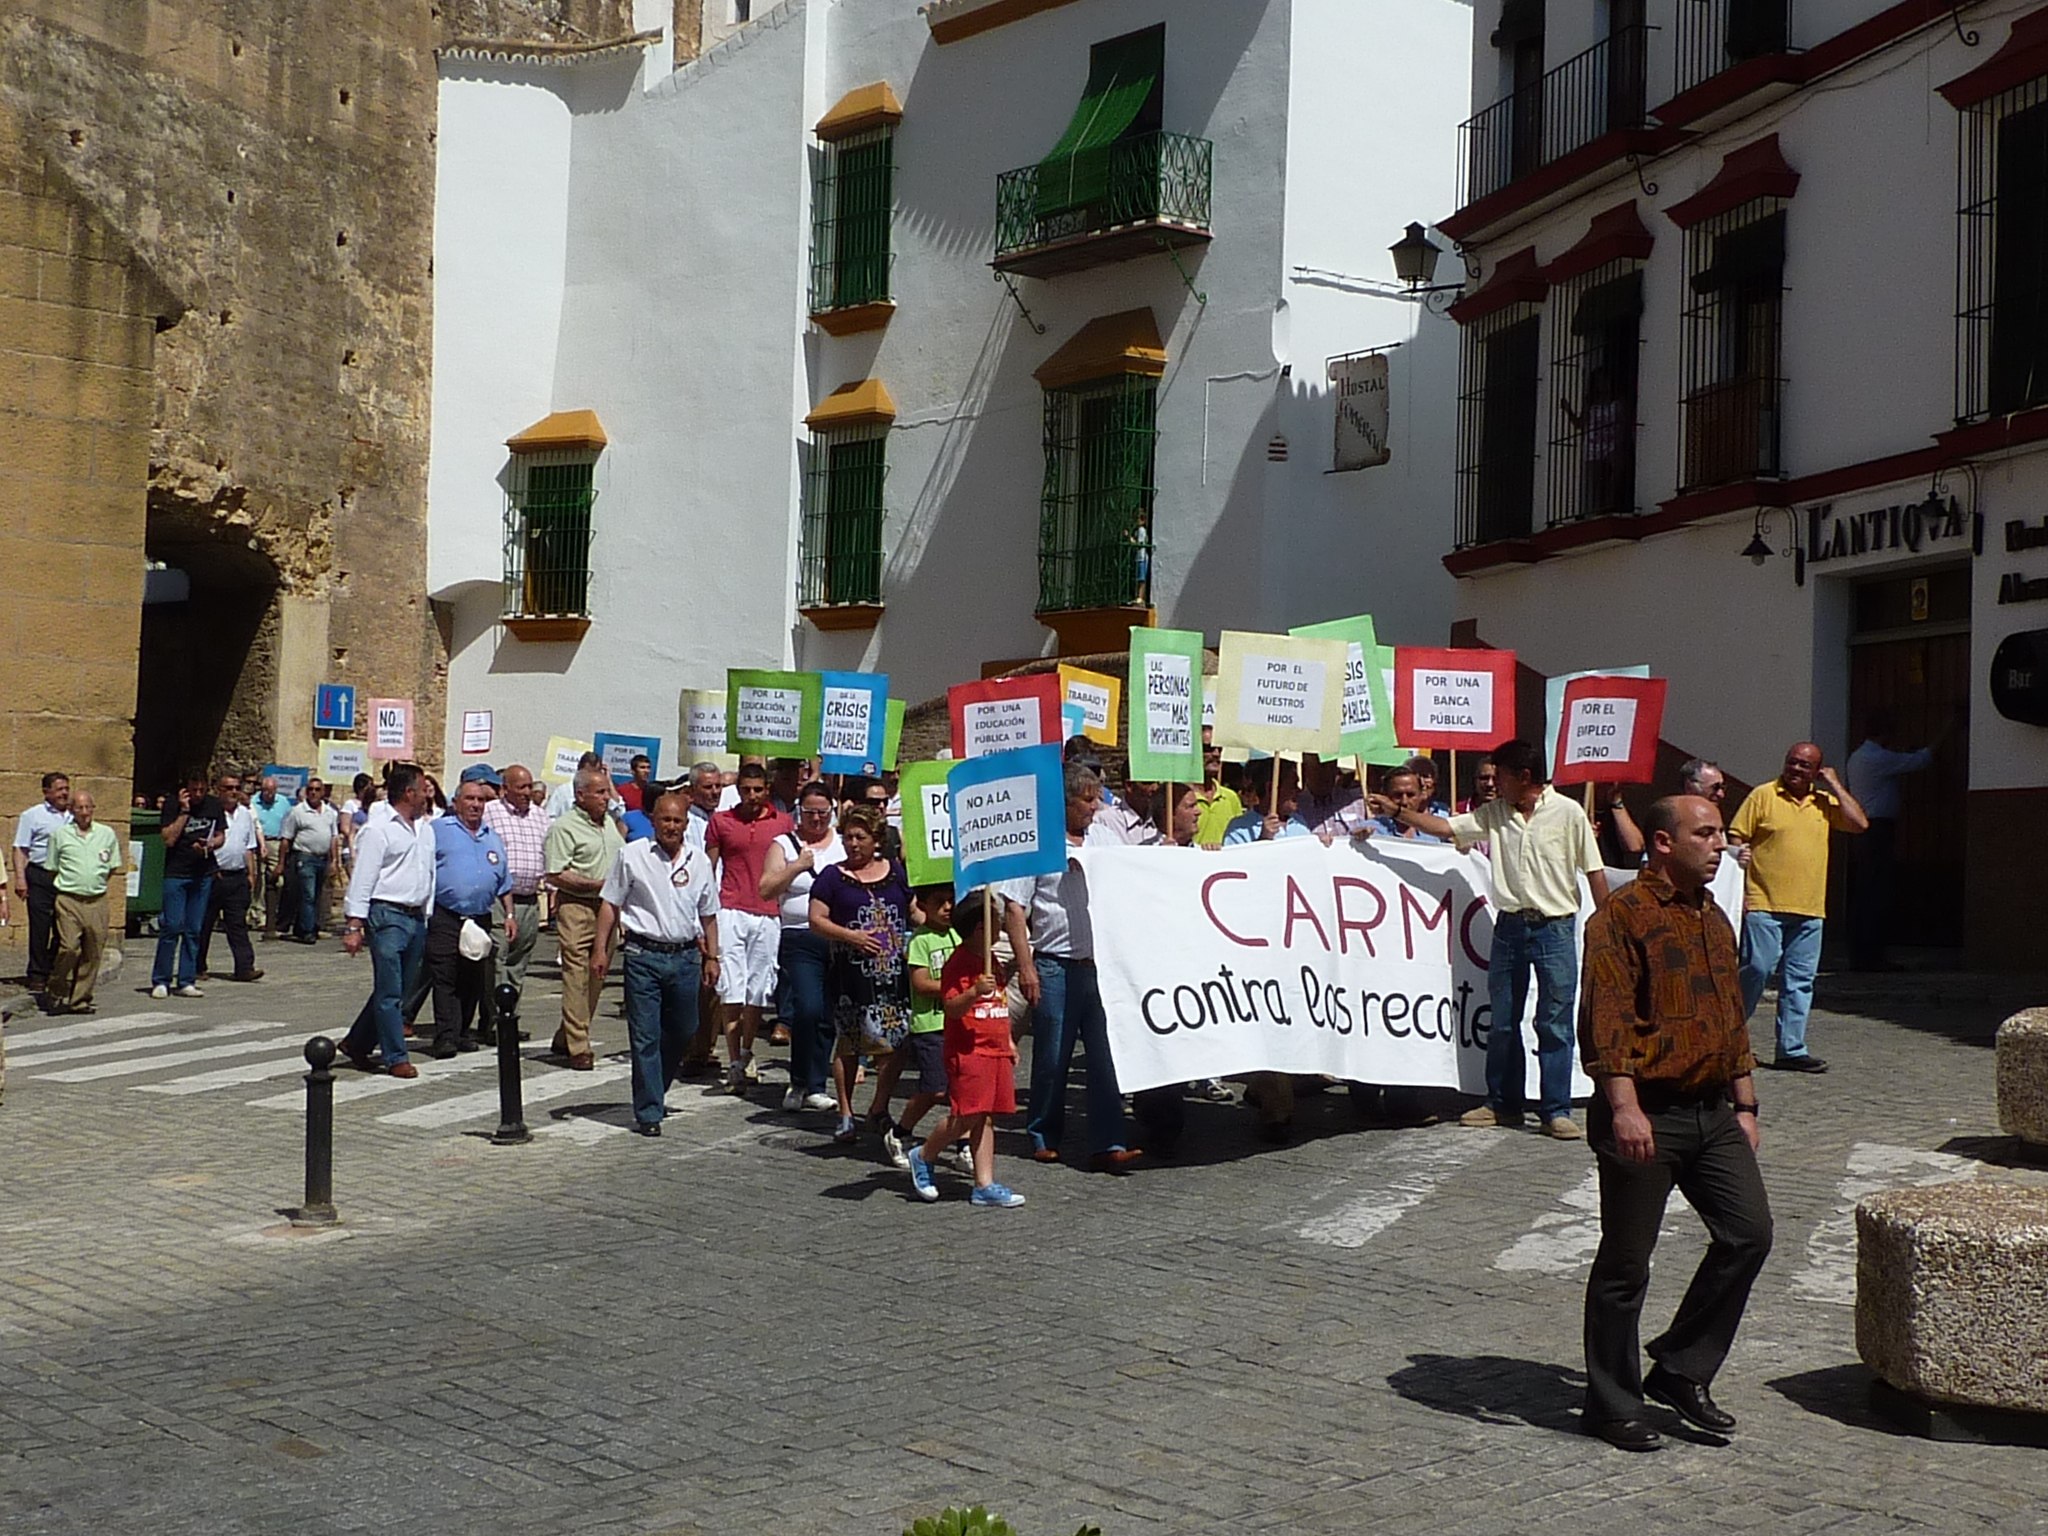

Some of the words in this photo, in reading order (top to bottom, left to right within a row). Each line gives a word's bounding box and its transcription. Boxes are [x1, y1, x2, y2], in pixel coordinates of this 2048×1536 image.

[1341, 377, 1386, 397] HOSTAL
[1151, 661, 1163, 672] LAS
[1267, 662, 1287, 673] POR
[1294, 664, 1303, 675] EL
[1148, 674, 1190, 697] PERSONAS
[1257, 678, 1295, 691] FUTURO
[1297, 682, 1308, 692] DE
[1425, 676, 1447, 687] POR
[1455, 677, 1480, 688] UNA
[2008, 669, 2032, 689] Bar
[752, 689, 768, 699] POR
[774, 691, 785, 699] LA
[1068, 689, 1100, 706] TRABAJO
[1101, 697, 1107, 707] Y
[1434, 695, 1470, 706] BANCA
[741, 701, 786, 712] EDUCACIÓN
[791, 705, 798, 713] Y
[1257, 695, 1305, 709] NUESTROS
[827, 701, 868, 718] CRISIS
[978, 704, 995, 715] POR
[1002, 703, 1021, 713] UNA
[1171, 701, 1189, 725] MÁS
[1582, 703, 1600, 716] POR
[1603, 703, 1615, 715] EL
[380, 710, 396, 727] NO
[694, 712, 705, 720] NO
[743, 714, 752, 722] LA
[755, 714, 792, 725] SANIDAD
[1267, 713, 1293, 725] HIJOS
[1430, 712, 1474, 725] PÚBLICA
[975, 717, 1025, 730] EDUCACIÓN
[749, 727, 764, 736] MIS
[767, 728, 798, 739] NIETOS
[975, 731, 1010, 744] PÚBLICA
[1016, 731, 1027, 740] DE
[1150, 728, 1190, 746] IMPORTANTES
[1577, 725, 1615, 737] EMPLEO
[824, 731, 866, 751] CULPABLES
[1577, 746, 1609, 759] DIGNO
[966, 796, 983, 810] NO
[986, 793, 994, 806] A
[996, 790, 1011, 803] LA
[1016, 808, 1033, 821] DE
[969, 830, 1036, 855] MERCADOS
[1142, 964, 1292, 1036] contra
[1300, 965, 1353, 1036] los
